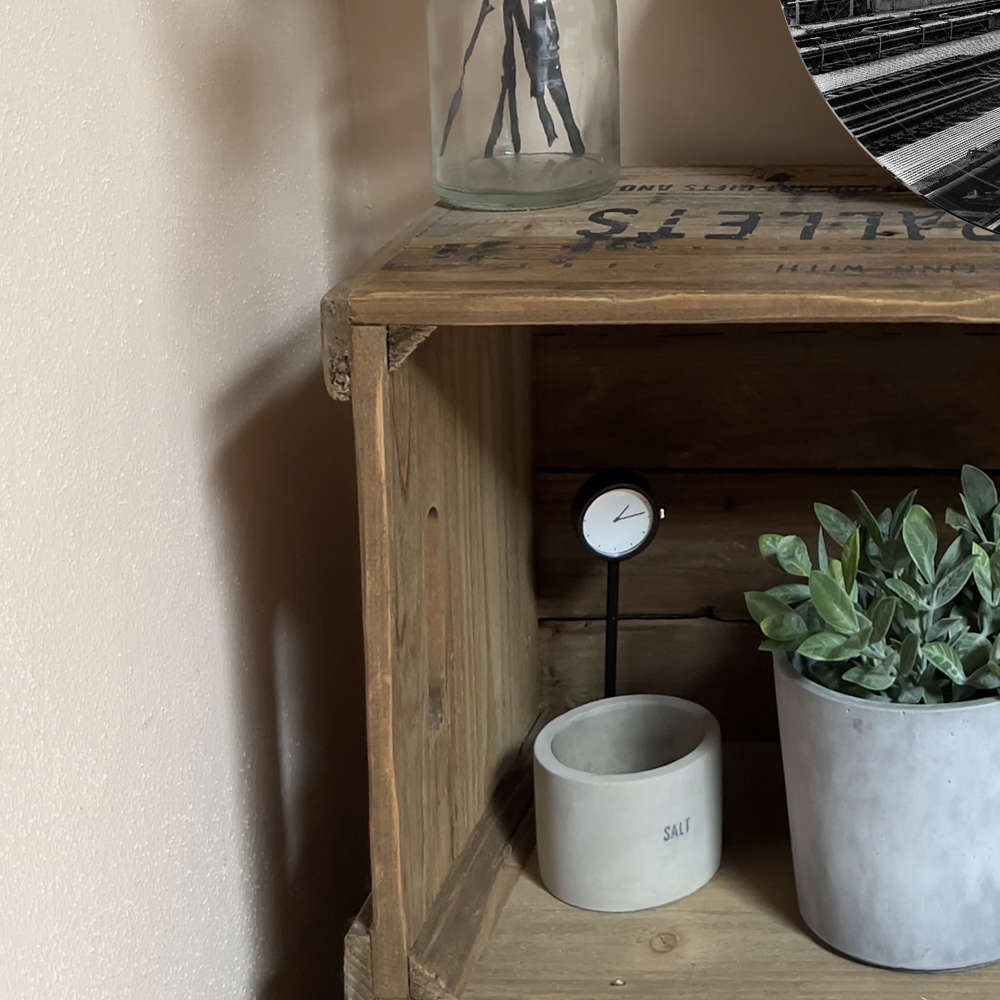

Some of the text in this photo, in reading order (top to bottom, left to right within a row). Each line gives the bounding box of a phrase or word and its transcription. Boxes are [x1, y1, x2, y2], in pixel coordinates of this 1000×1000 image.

[619, 184, 673, 192] AND
[776, 263, 864, 273] WITH
[663, 816, 692, 842] SALT
